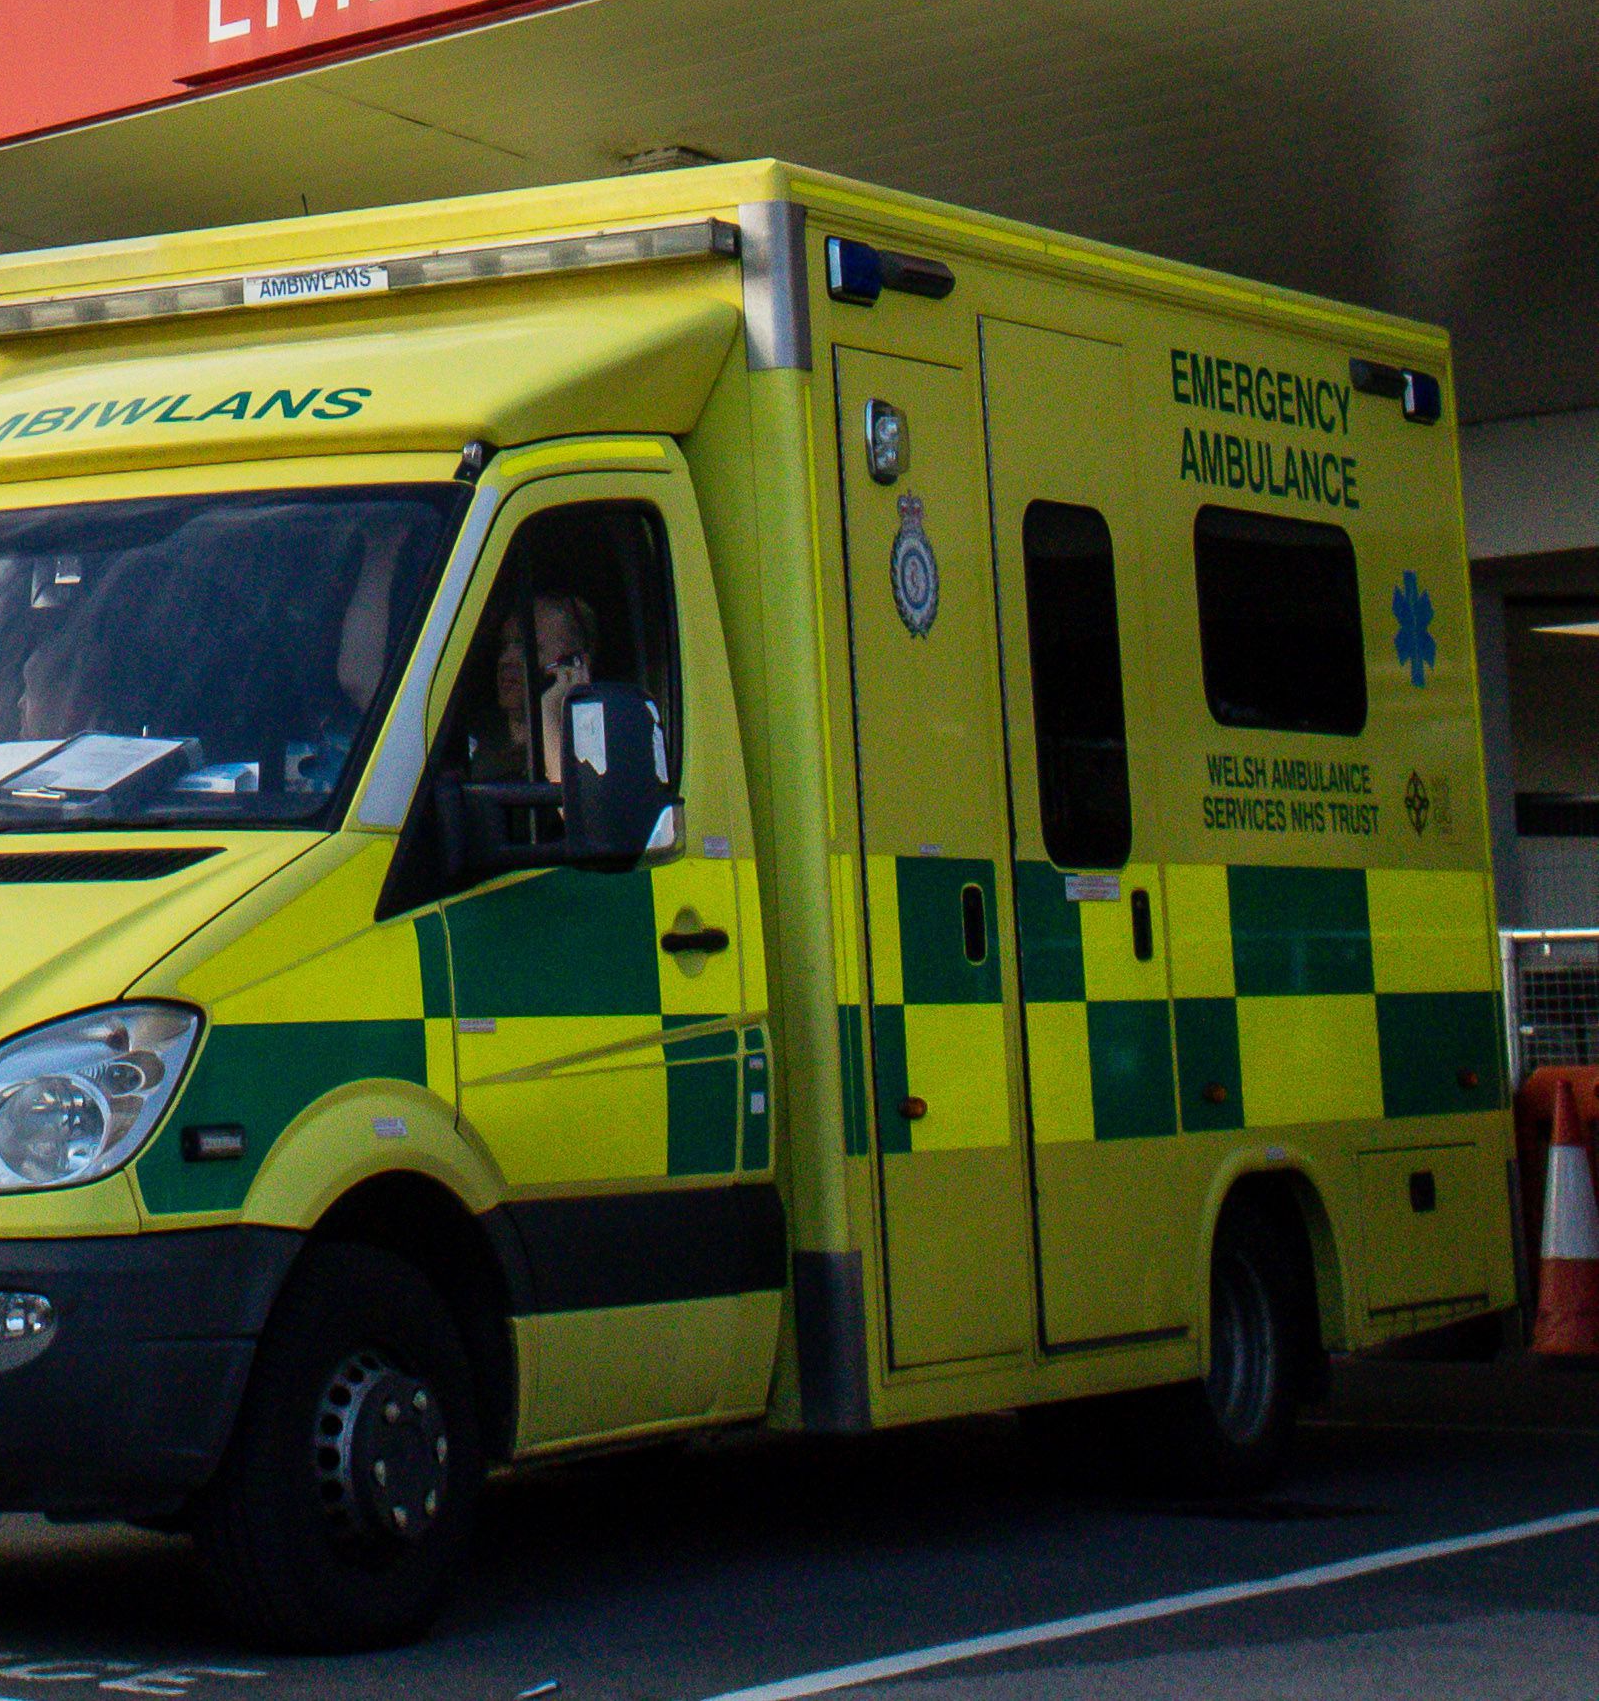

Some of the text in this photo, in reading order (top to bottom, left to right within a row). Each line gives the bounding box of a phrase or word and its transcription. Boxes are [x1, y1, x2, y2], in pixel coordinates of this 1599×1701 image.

[259, 266, 372, 299] AMBIWLANS
[1170, 348, 1351, 435] EMERGENCY
[1180, 426, 1360, 510] AMBULANCE
[1206, 754, 1372, 795] WELSH AMBULANCE
[1202, 795, 1380, 836] SERVICES NHS TRUST
